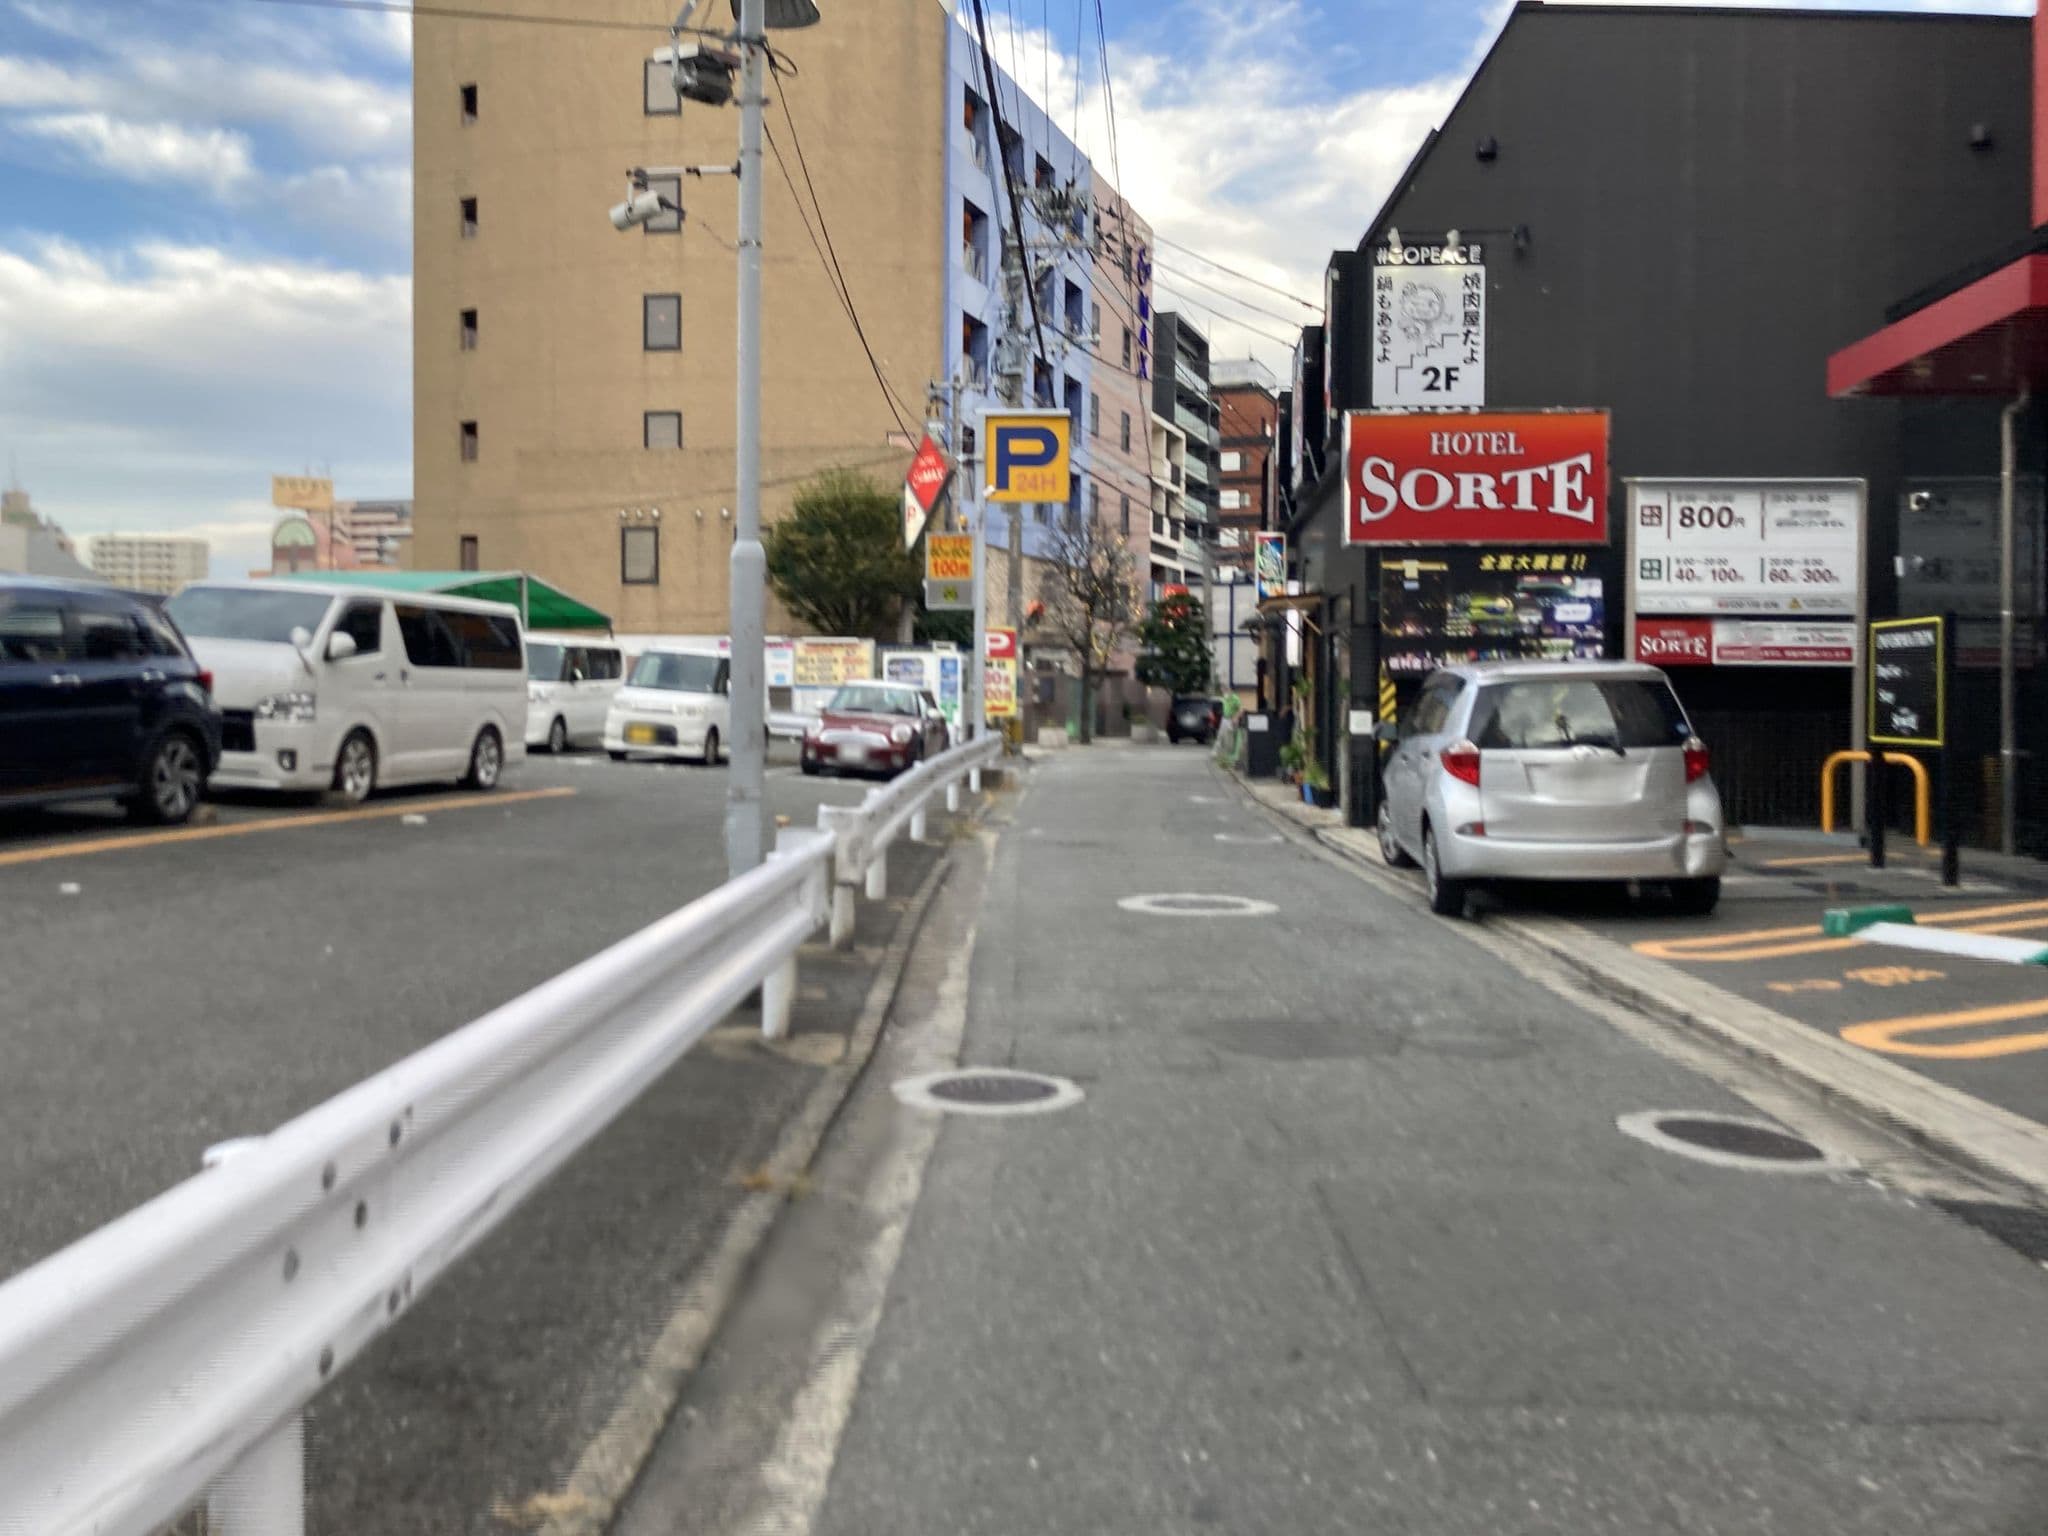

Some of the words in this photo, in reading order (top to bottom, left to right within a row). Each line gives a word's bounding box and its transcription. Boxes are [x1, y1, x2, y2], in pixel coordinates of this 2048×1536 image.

[1421, 366, 1460, 392] 2F
[1429, 432, 1525, 456] HOTEL
[996, 426, 1060, 490] P
[1016, 473, 1057, 492] 24H
[1359, 452, 1595, 525] SORTE
[1641, 635, 1708, 657] SORTE
